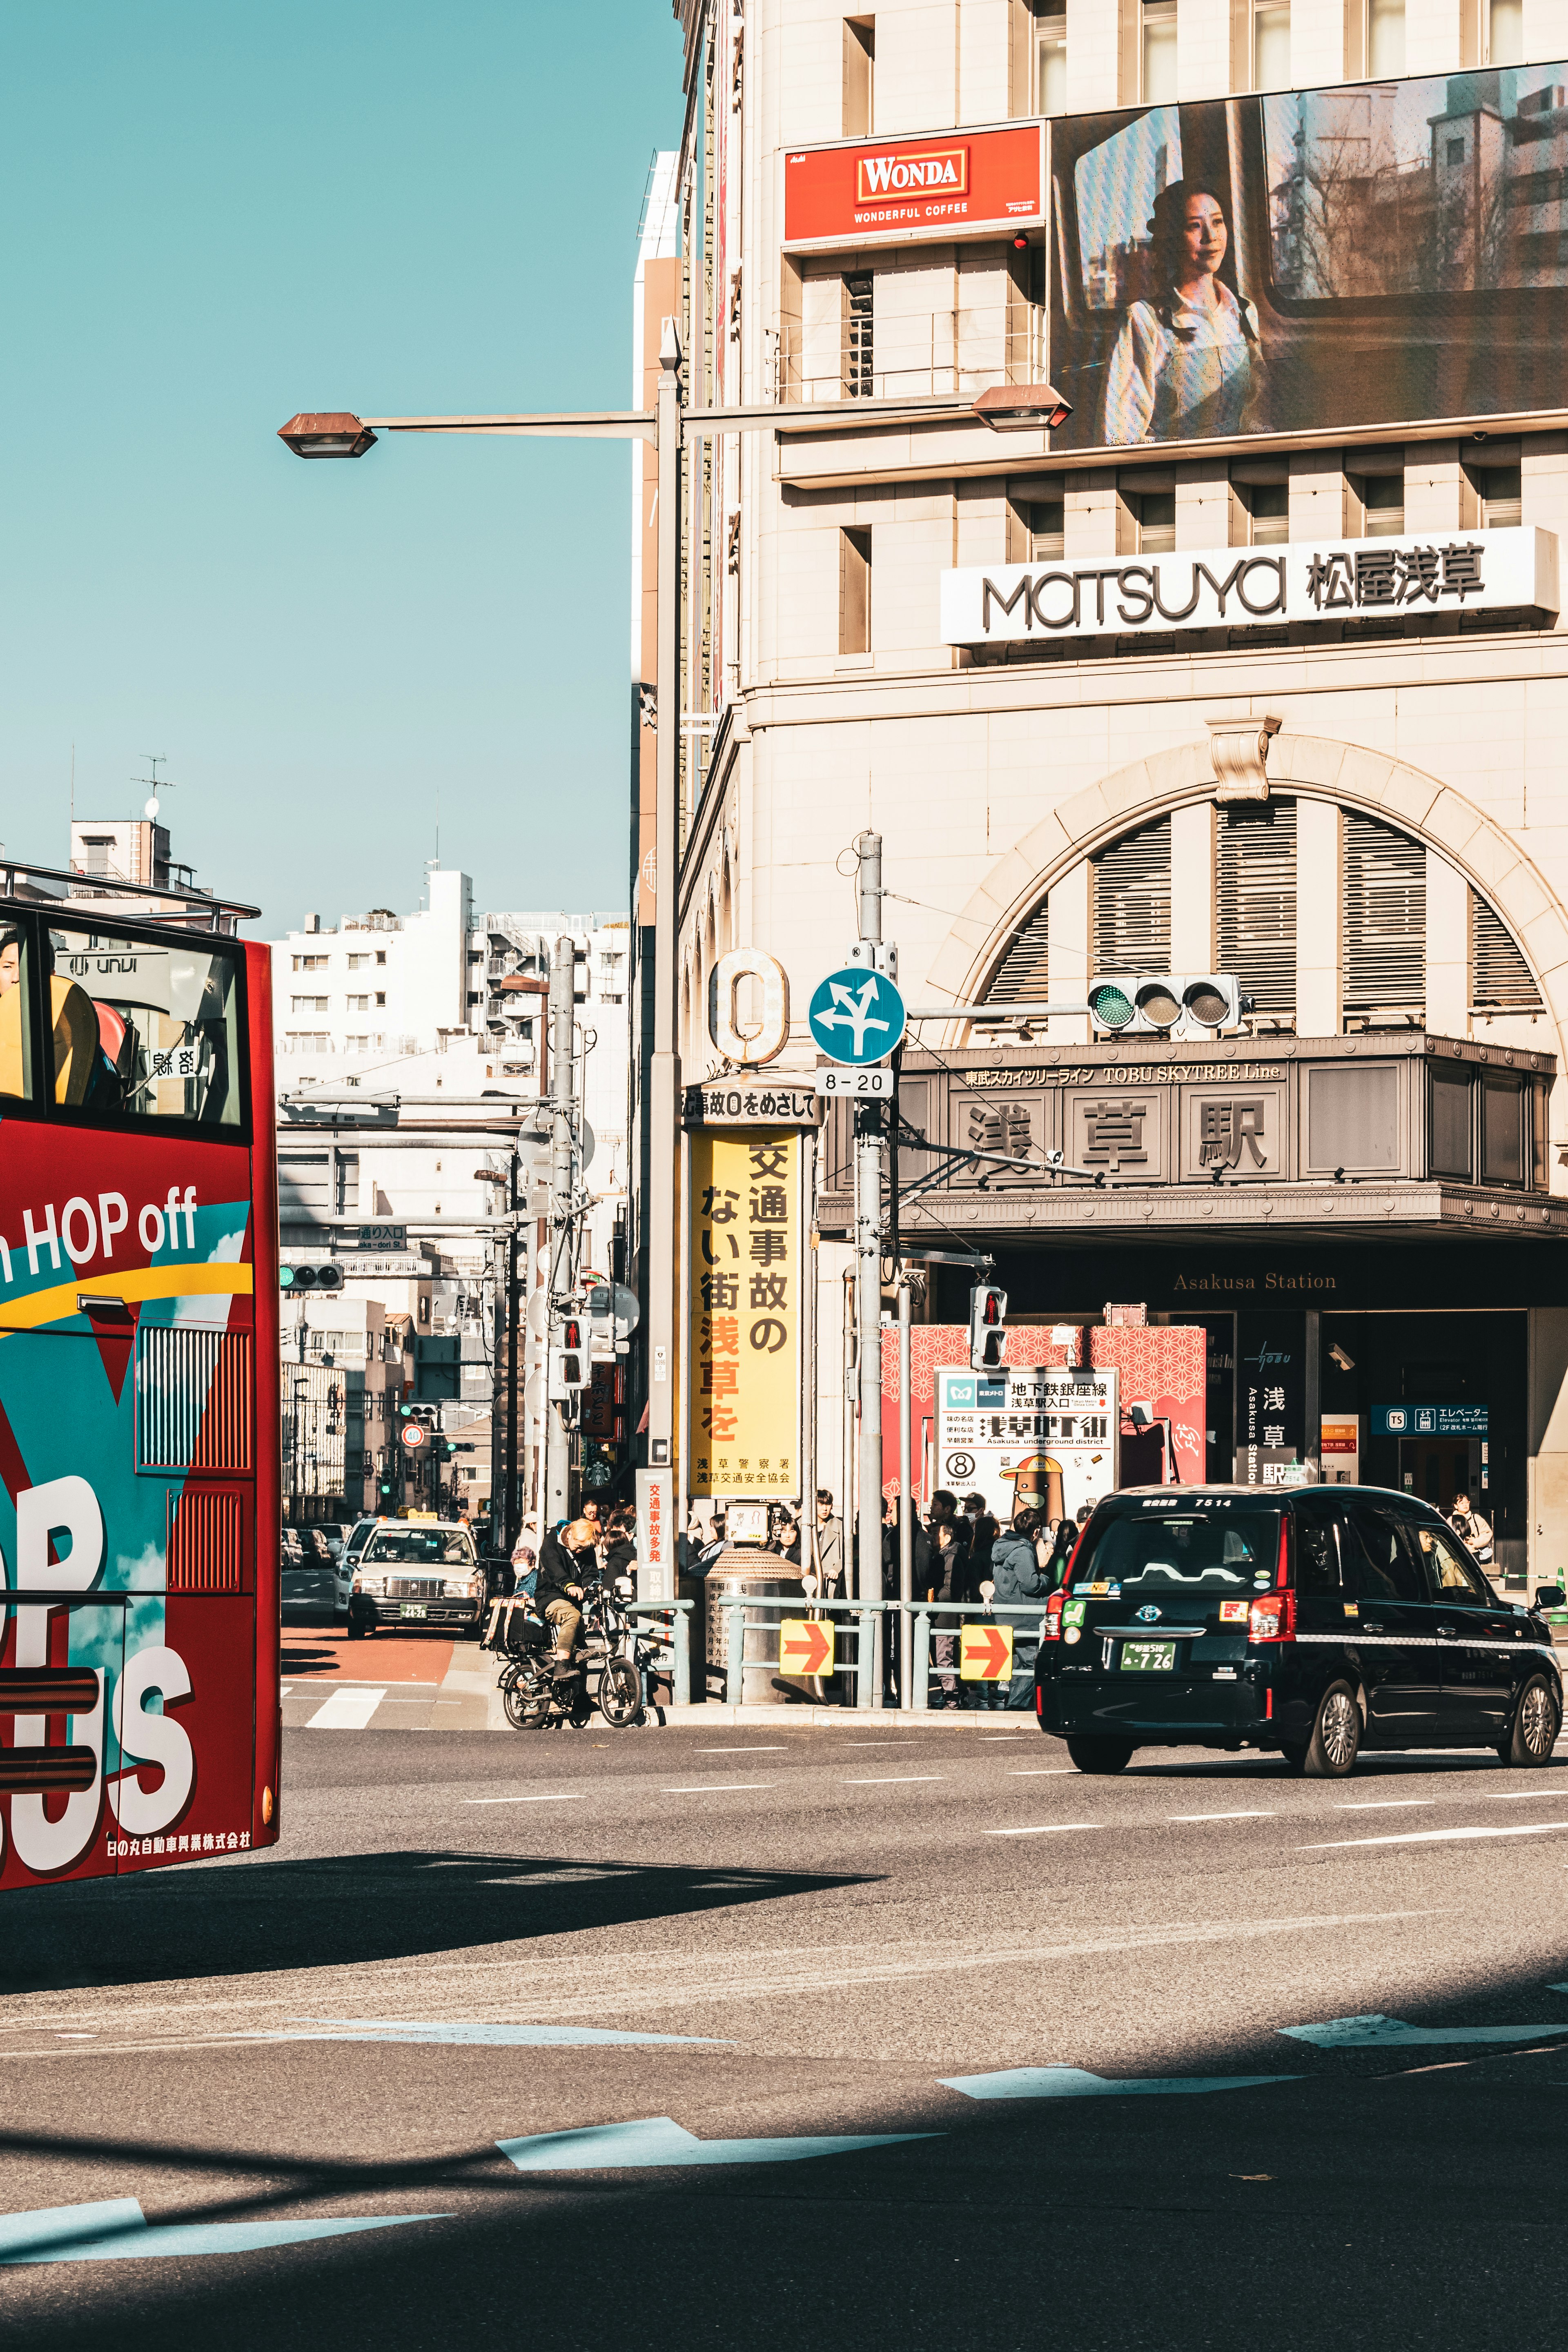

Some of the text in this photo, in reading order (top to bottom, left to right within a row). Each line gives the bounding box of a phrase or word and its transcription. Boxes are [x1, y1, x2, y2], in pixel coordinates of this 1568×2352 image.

[863, 157, 958, 193] WONDA
[854, 203, 968, 223] WONDERFUL COFFEE
[1306, 541, 1485, 611] 松屋浅草
[965, 1063, 1280, 1086] 東武スカイツリーライン TOBU SKYTREE Line
[967, 1099, 1267, 1175] 浅草駅
[23, 1192, 128, 1275] HOP
[138, 1186, 197, 1252] off
[749, 1142, 788, 1354] 交通事故の
[1174, 1272, 1336, 1290] Asakusa Station
[700, 1186, 740, 1441] ない街浅草を
[1011, 1383, 1107, 1396] 地下鉄銀座線
[1011, 1398, 1069, 1408] 浅草駅入口
[1249, 1388, 1257, 1439] Asakusa
[1439, 1409, 1488, 1417] エレベーター
[980, 1416, 1107, 1438] 浅草地下街
[1391, 1416, 1402, 1424] TS
[408, 1431, 418, 1440] 40
[1263, 1387, 1285, 1483] 浅草駅
[697, 1458, 790, 1470] 浅草警察署
[697, 1472, 790, 1483] 浅草交通安全協会
[649, 1484, 661, 1562] 交通事故多発
[107, 1831, 251, 1856] 日の丸自動車興業株式会社
